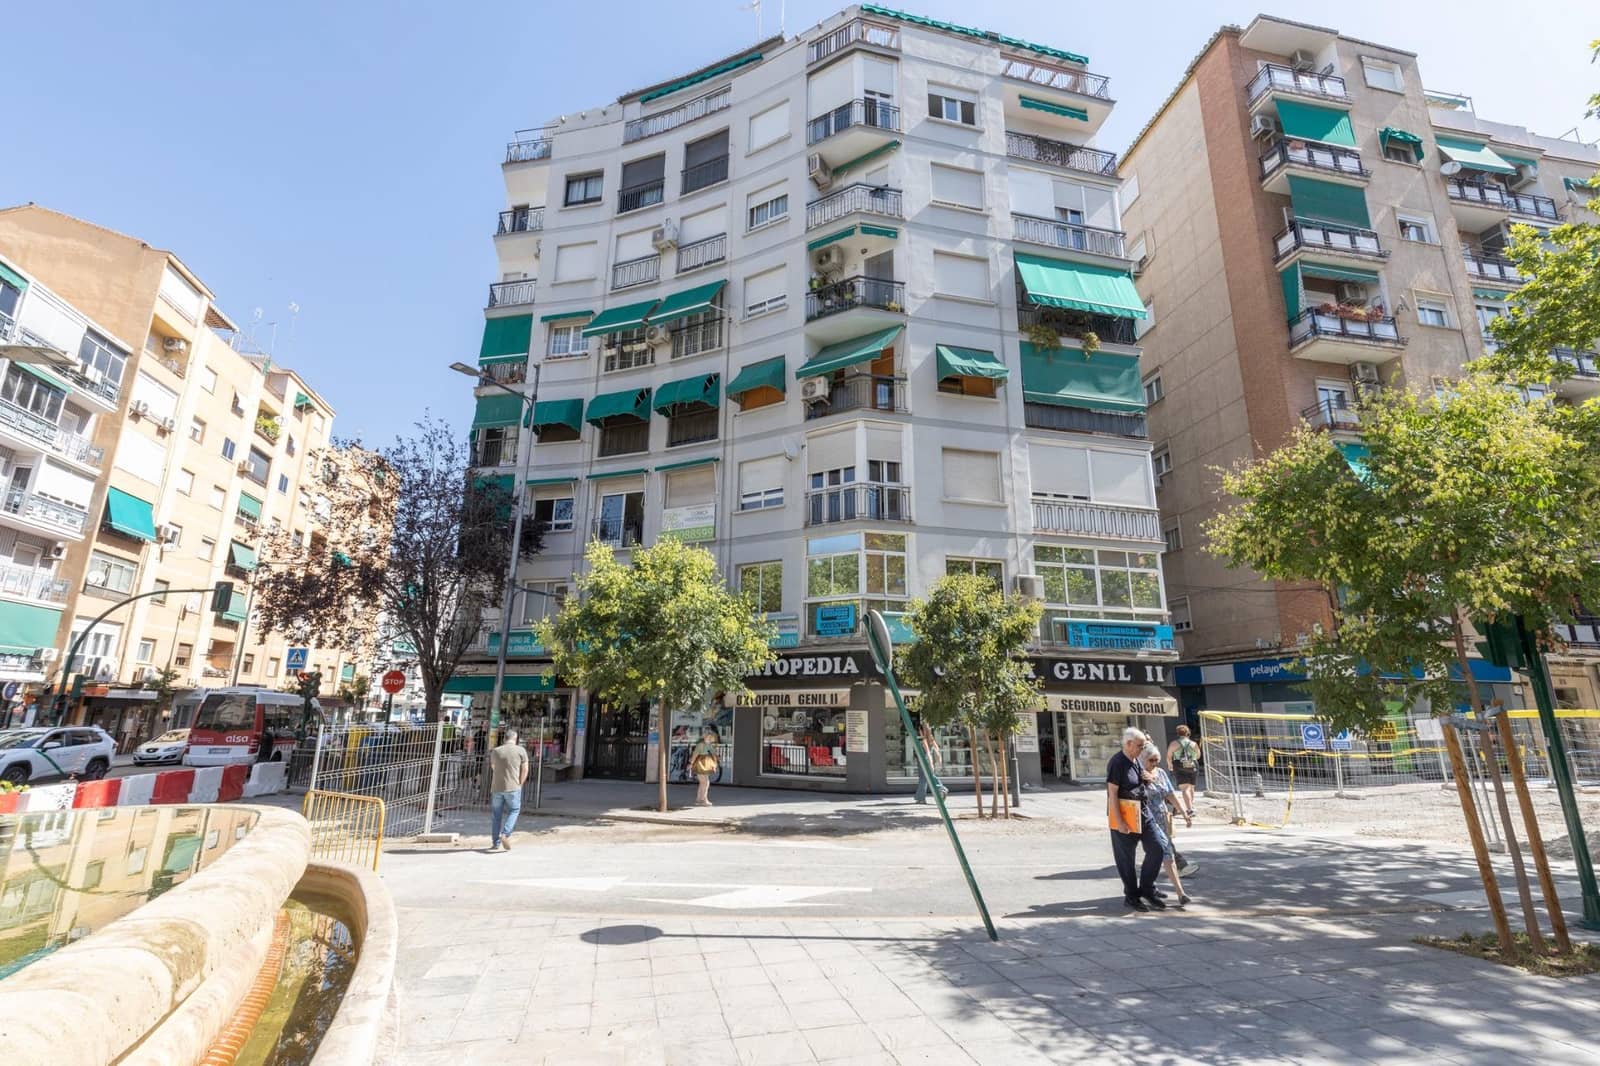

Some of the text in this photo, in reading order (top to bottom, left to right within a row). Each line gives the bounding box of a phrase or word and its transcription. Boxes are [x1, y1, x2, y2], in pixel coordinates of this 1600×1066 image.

[1053, 662, 1165, 682] GENIL II
[1250, 664, 1280, 678] pelayo
[798, 693, 828, 705] GENIL
[830, 693, 838, 704] II
[1061, 699, 1167, 714] SEGURIDAD SOCIAL
[225, 735, 249, 743] alsa
